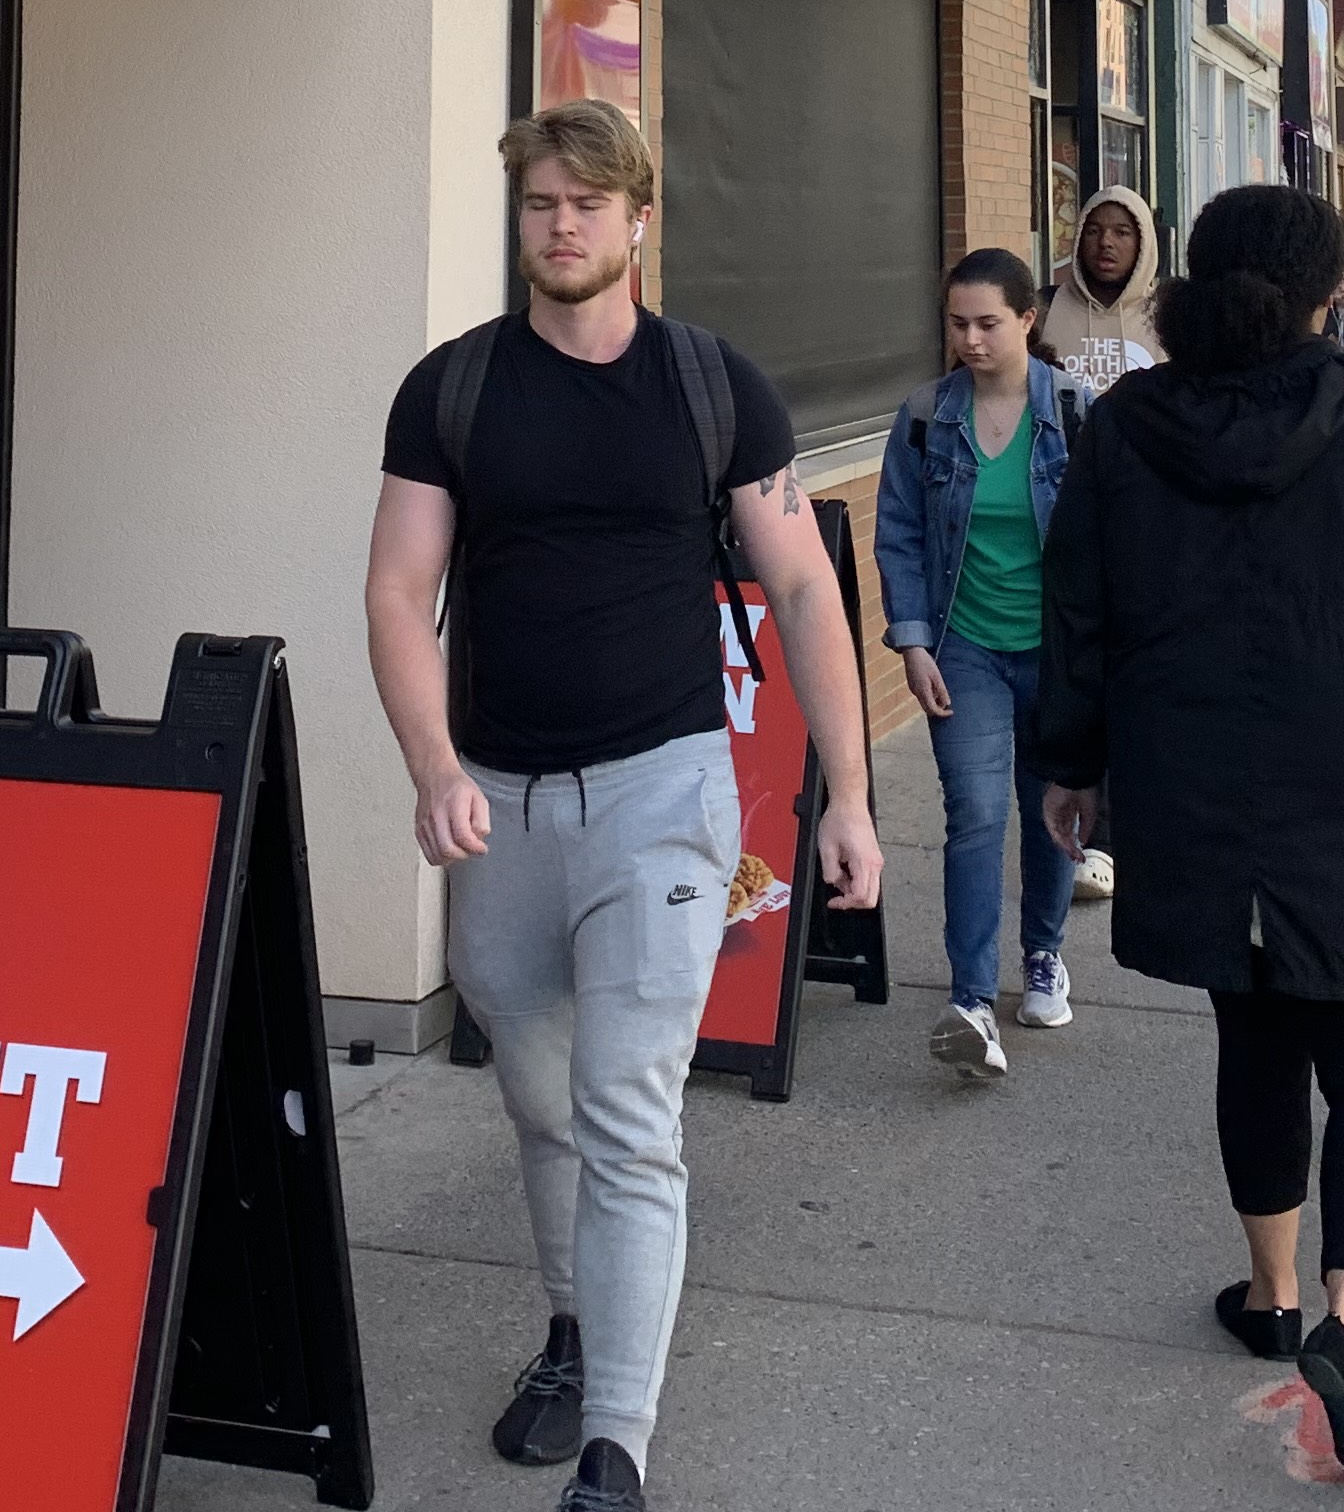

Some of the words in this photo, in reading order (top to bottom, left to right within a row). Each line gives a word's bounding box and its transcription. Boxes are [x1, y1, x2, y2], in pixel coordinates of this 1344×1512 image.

[1080, 338, 1120, 355] THE
[1059, 355, 1121, 374] ORTH
[672, 884, 698, 897] NIKE
